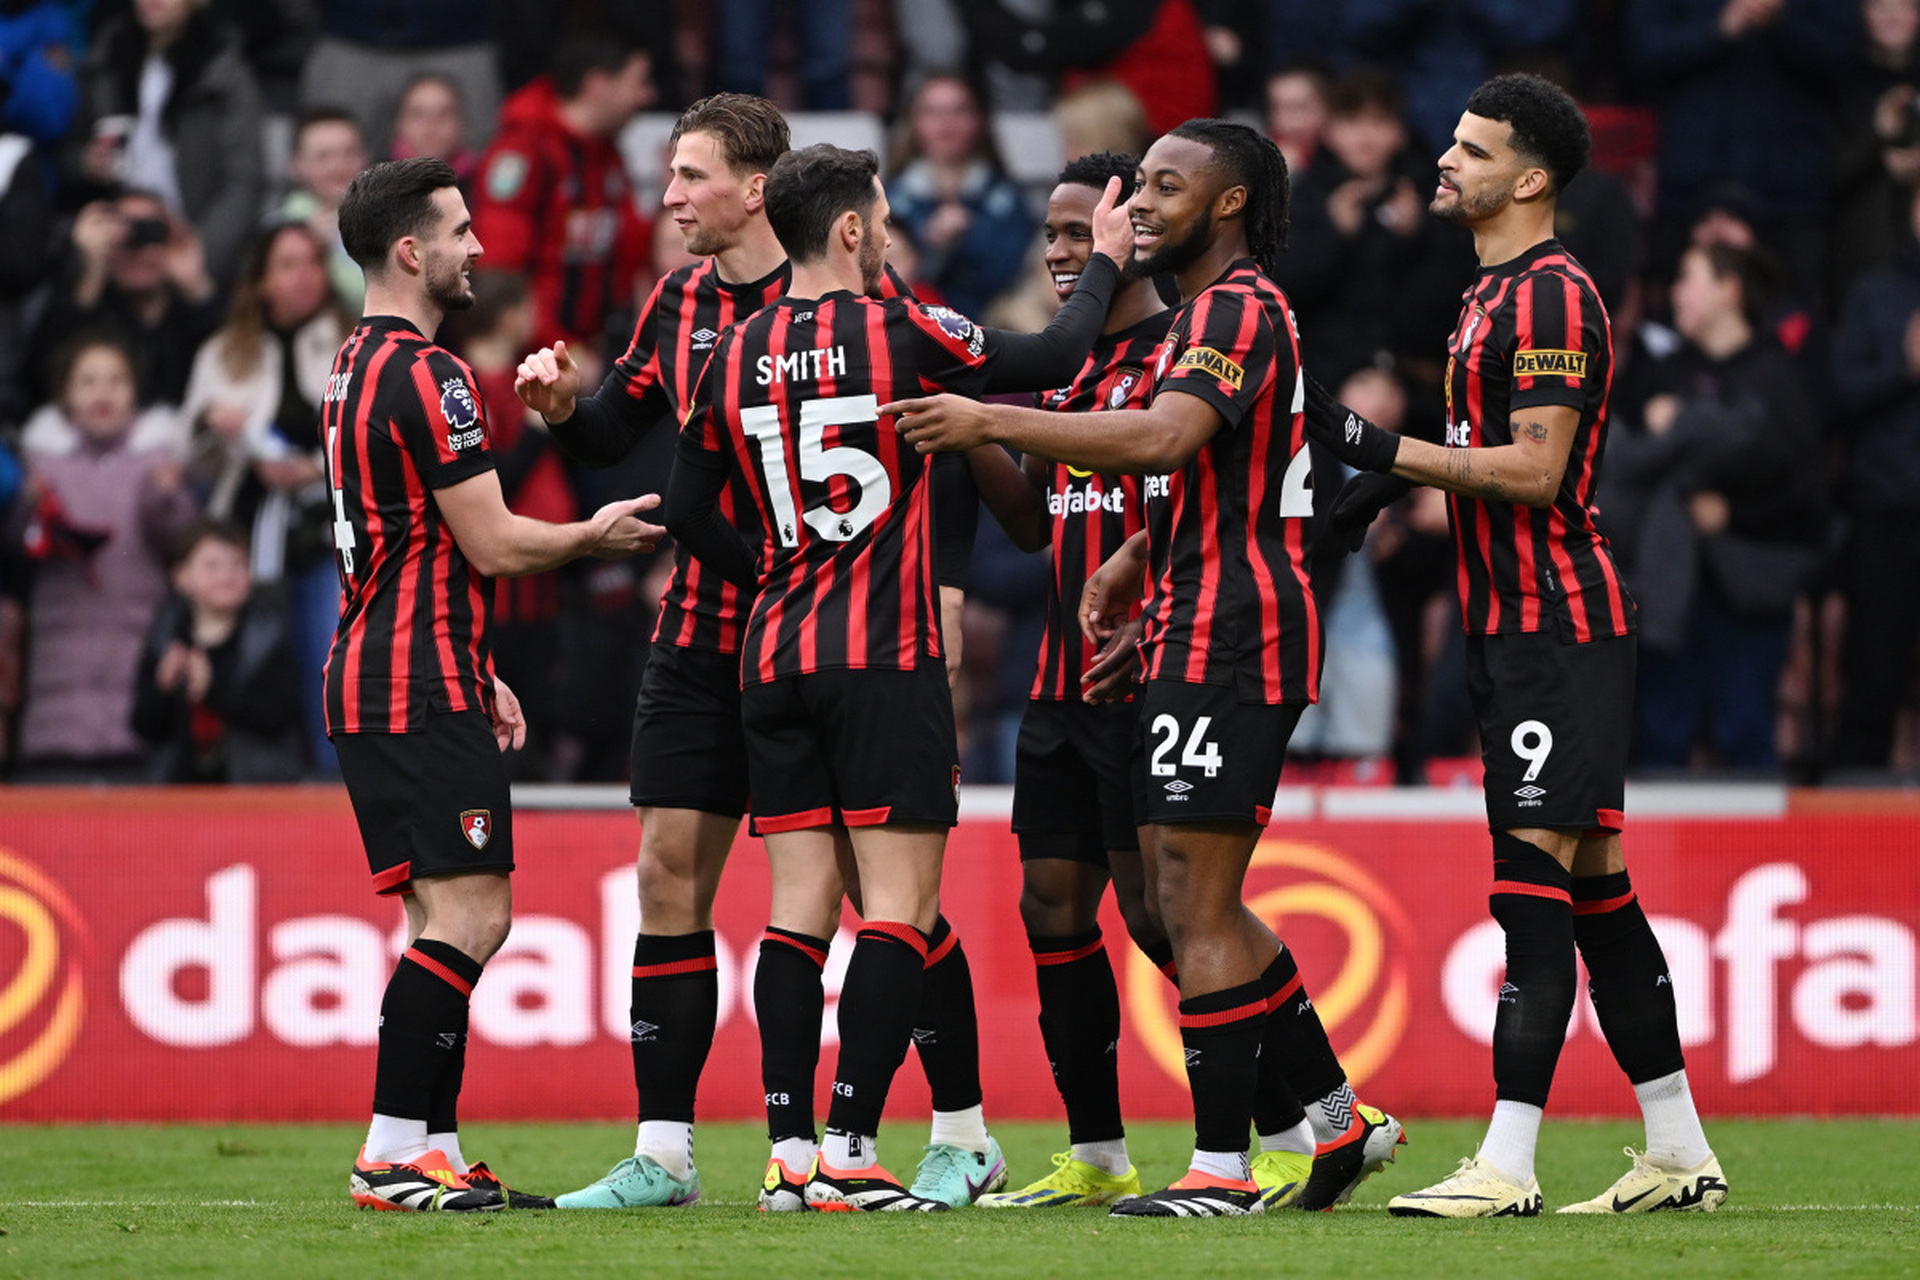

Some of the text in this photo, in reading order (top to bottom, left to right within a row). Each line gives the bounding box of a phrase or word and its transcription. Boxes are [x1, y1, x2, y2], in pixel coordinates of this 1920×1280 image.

[756, 345, 846, 385] SMITH
[740, 394, 891, 548] 15
[1151, 713, 1223, 778] 24
[1511, 720, 1553, 782] 9
